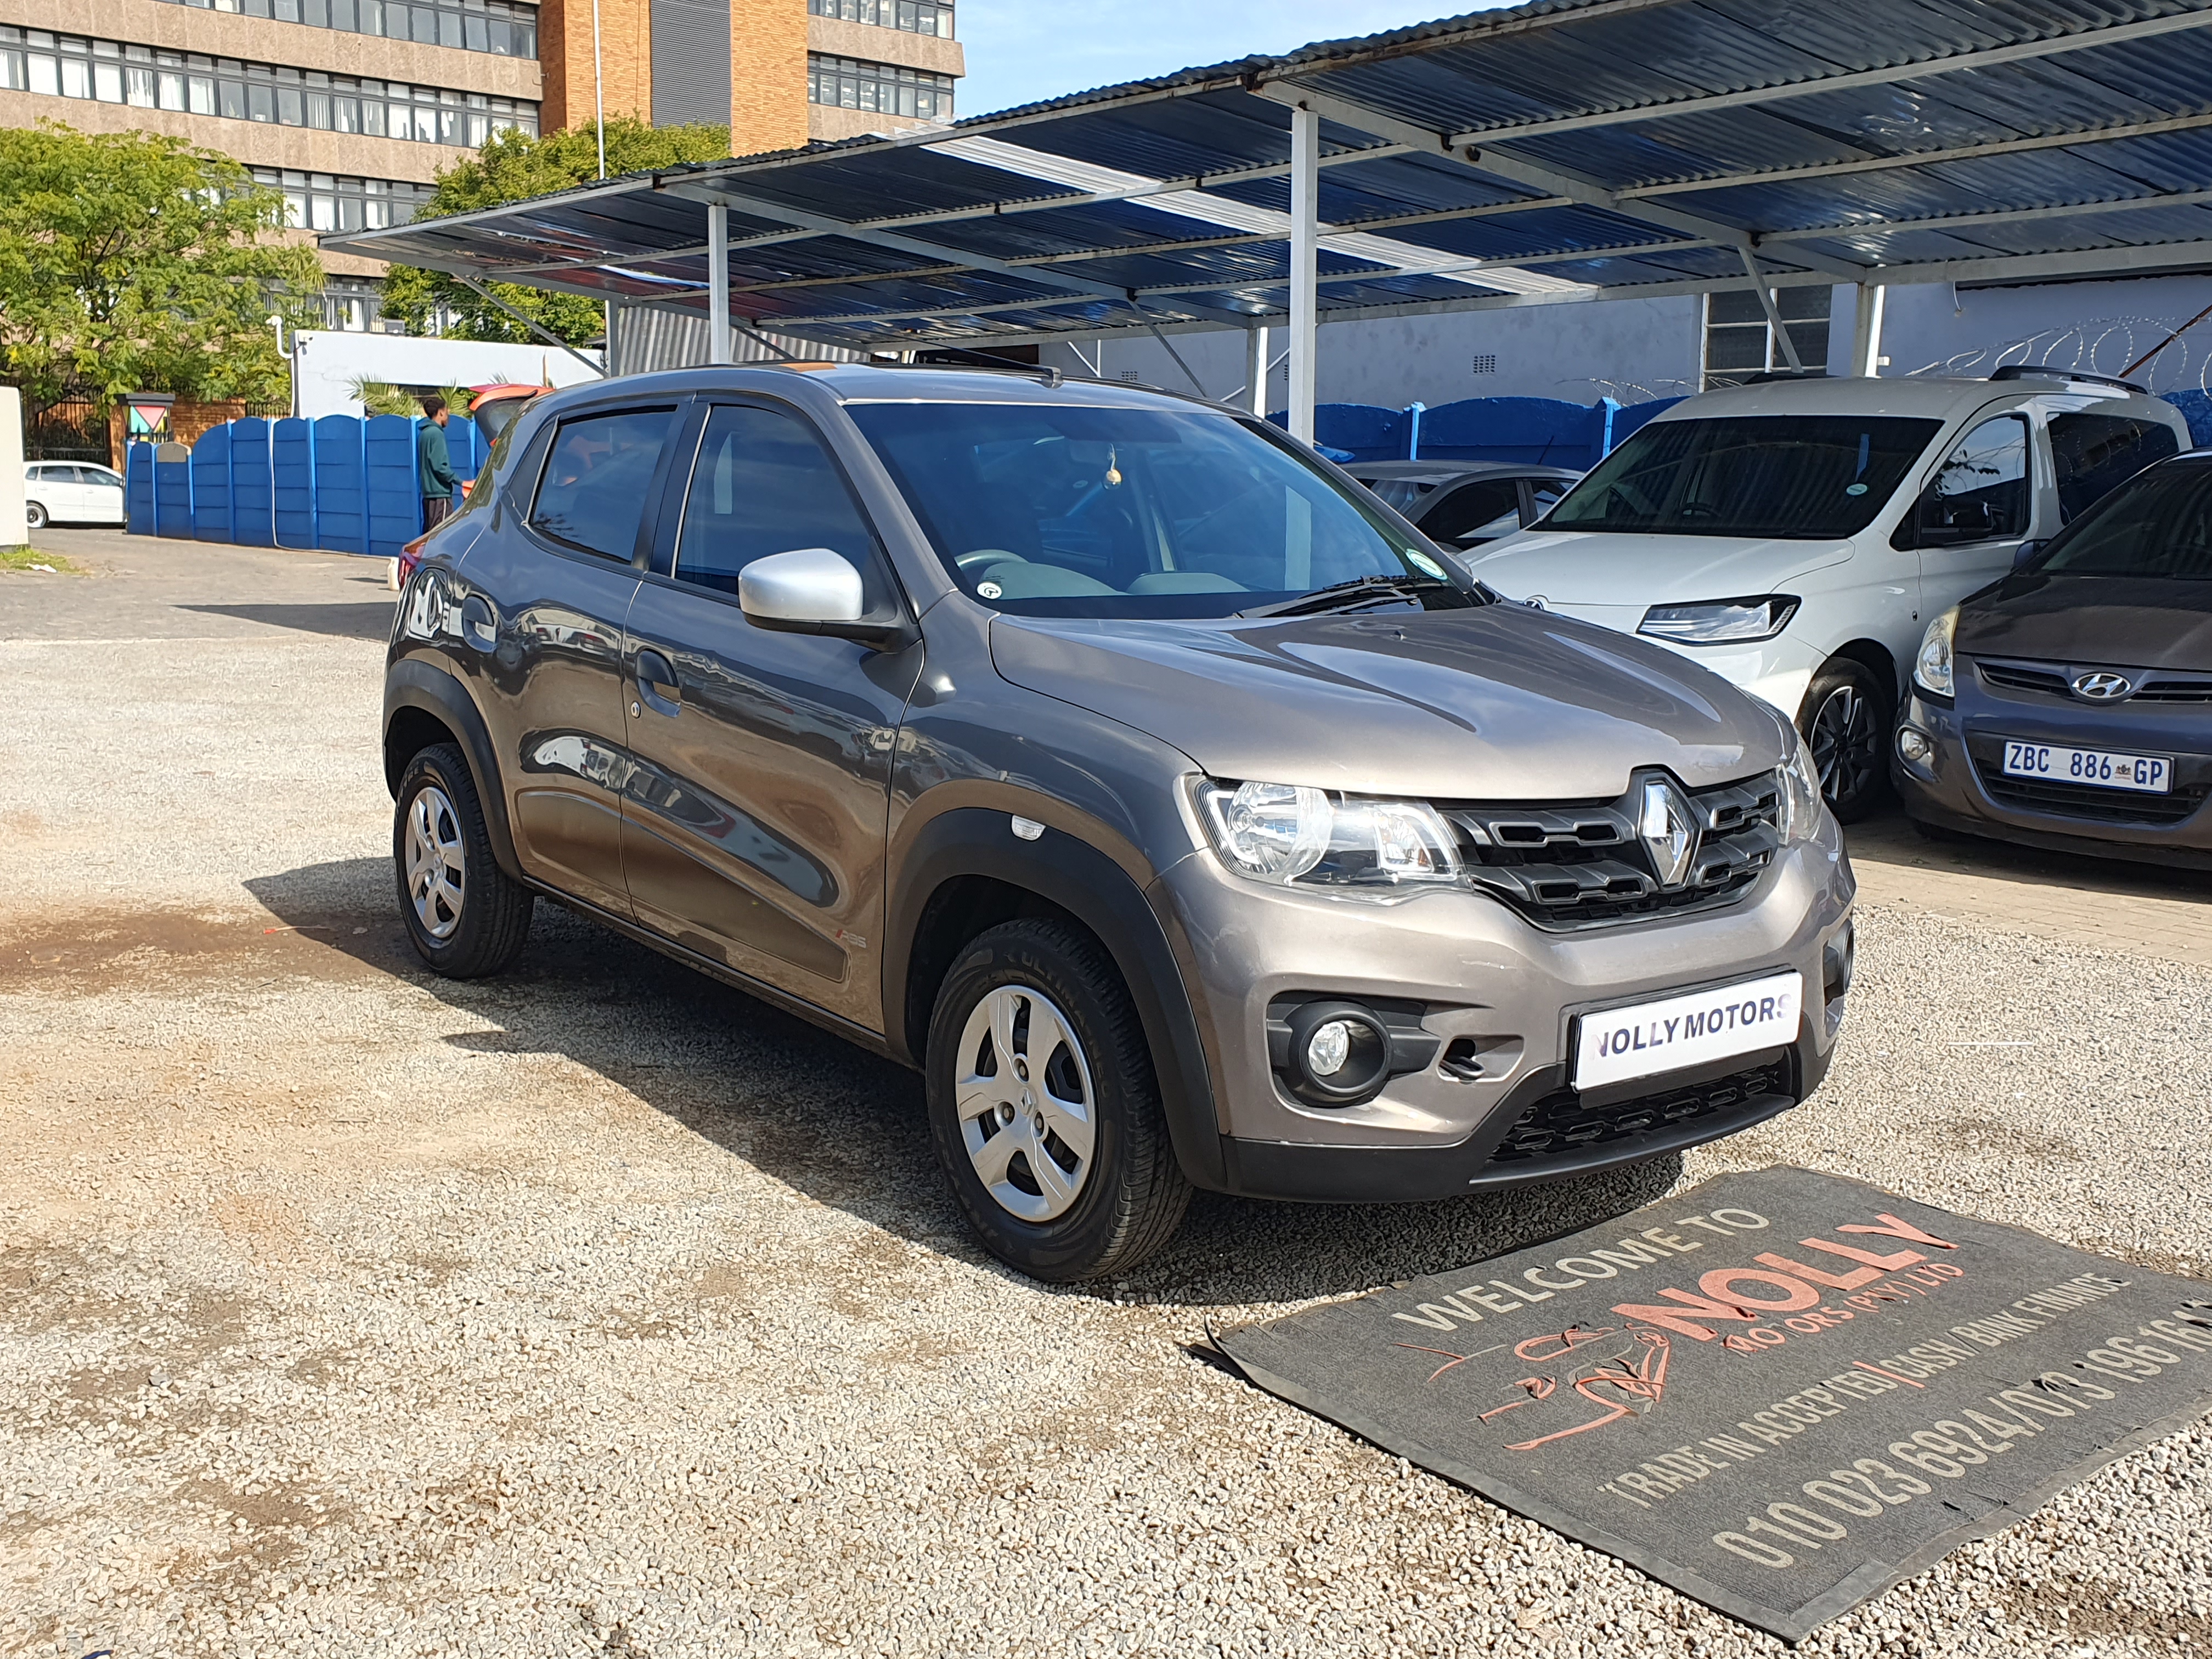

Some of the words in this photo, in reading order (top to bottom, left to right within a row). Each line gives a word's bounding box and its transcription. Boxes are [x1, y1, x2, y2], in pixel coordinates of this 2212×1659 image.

[2009, 744, 2050, 772] ZBC
[2070, 752, 2112, 780] 886
[2134, 759, 2163, 786] GP
[1589, 1017, 1681, 1060] NOLLY
[1684, 992, 1792, 1040] MOTORS
[1391, 1226, 1703, 1331] WELCOME
[1674, 1207, 1770, 1236] TO
[1609, 1211, 1961, 1342] NOLLY
[1904, 1262, 1965, 1287] LTD
[1595, 1444, 1733, 1509] TRADE
[1699, 1432, 1767, 1461] IN
[1736, 1370, 1899, 1446] ACCEPTED
[2011, 1272, 2132, 1319] FINANCE
[1712, 1501, 1848, 1569] 010
[1802, 1457, 1933, 1518] 023
[2072, 1336, 2182, 1384] 196
[2137, 1296, 2212, 1353] 16
